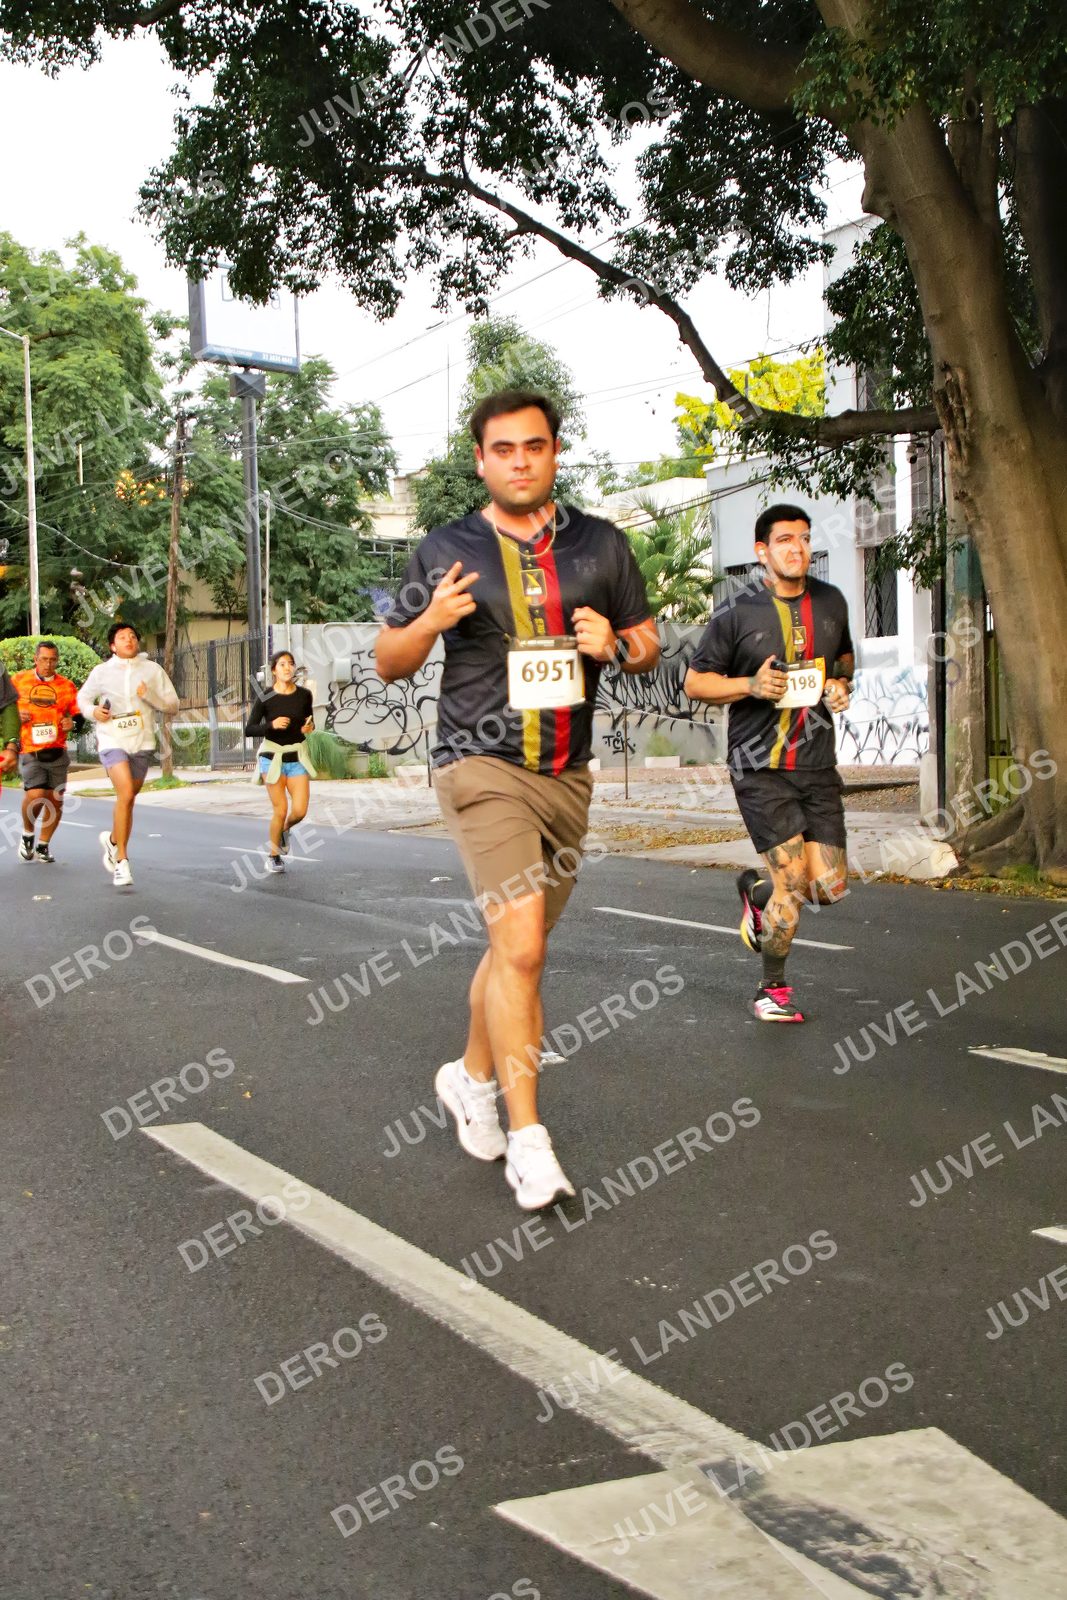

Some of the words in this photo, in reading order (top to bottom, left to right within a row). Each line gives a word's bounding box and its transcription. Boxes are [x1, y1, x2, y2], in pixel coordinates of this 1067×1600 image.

[521, 658, 575, 683] 6951
[785, 673, 816, 691] 198
[117, 718, 138, 729] 4245
[36, 727, 53, 737] 2858
